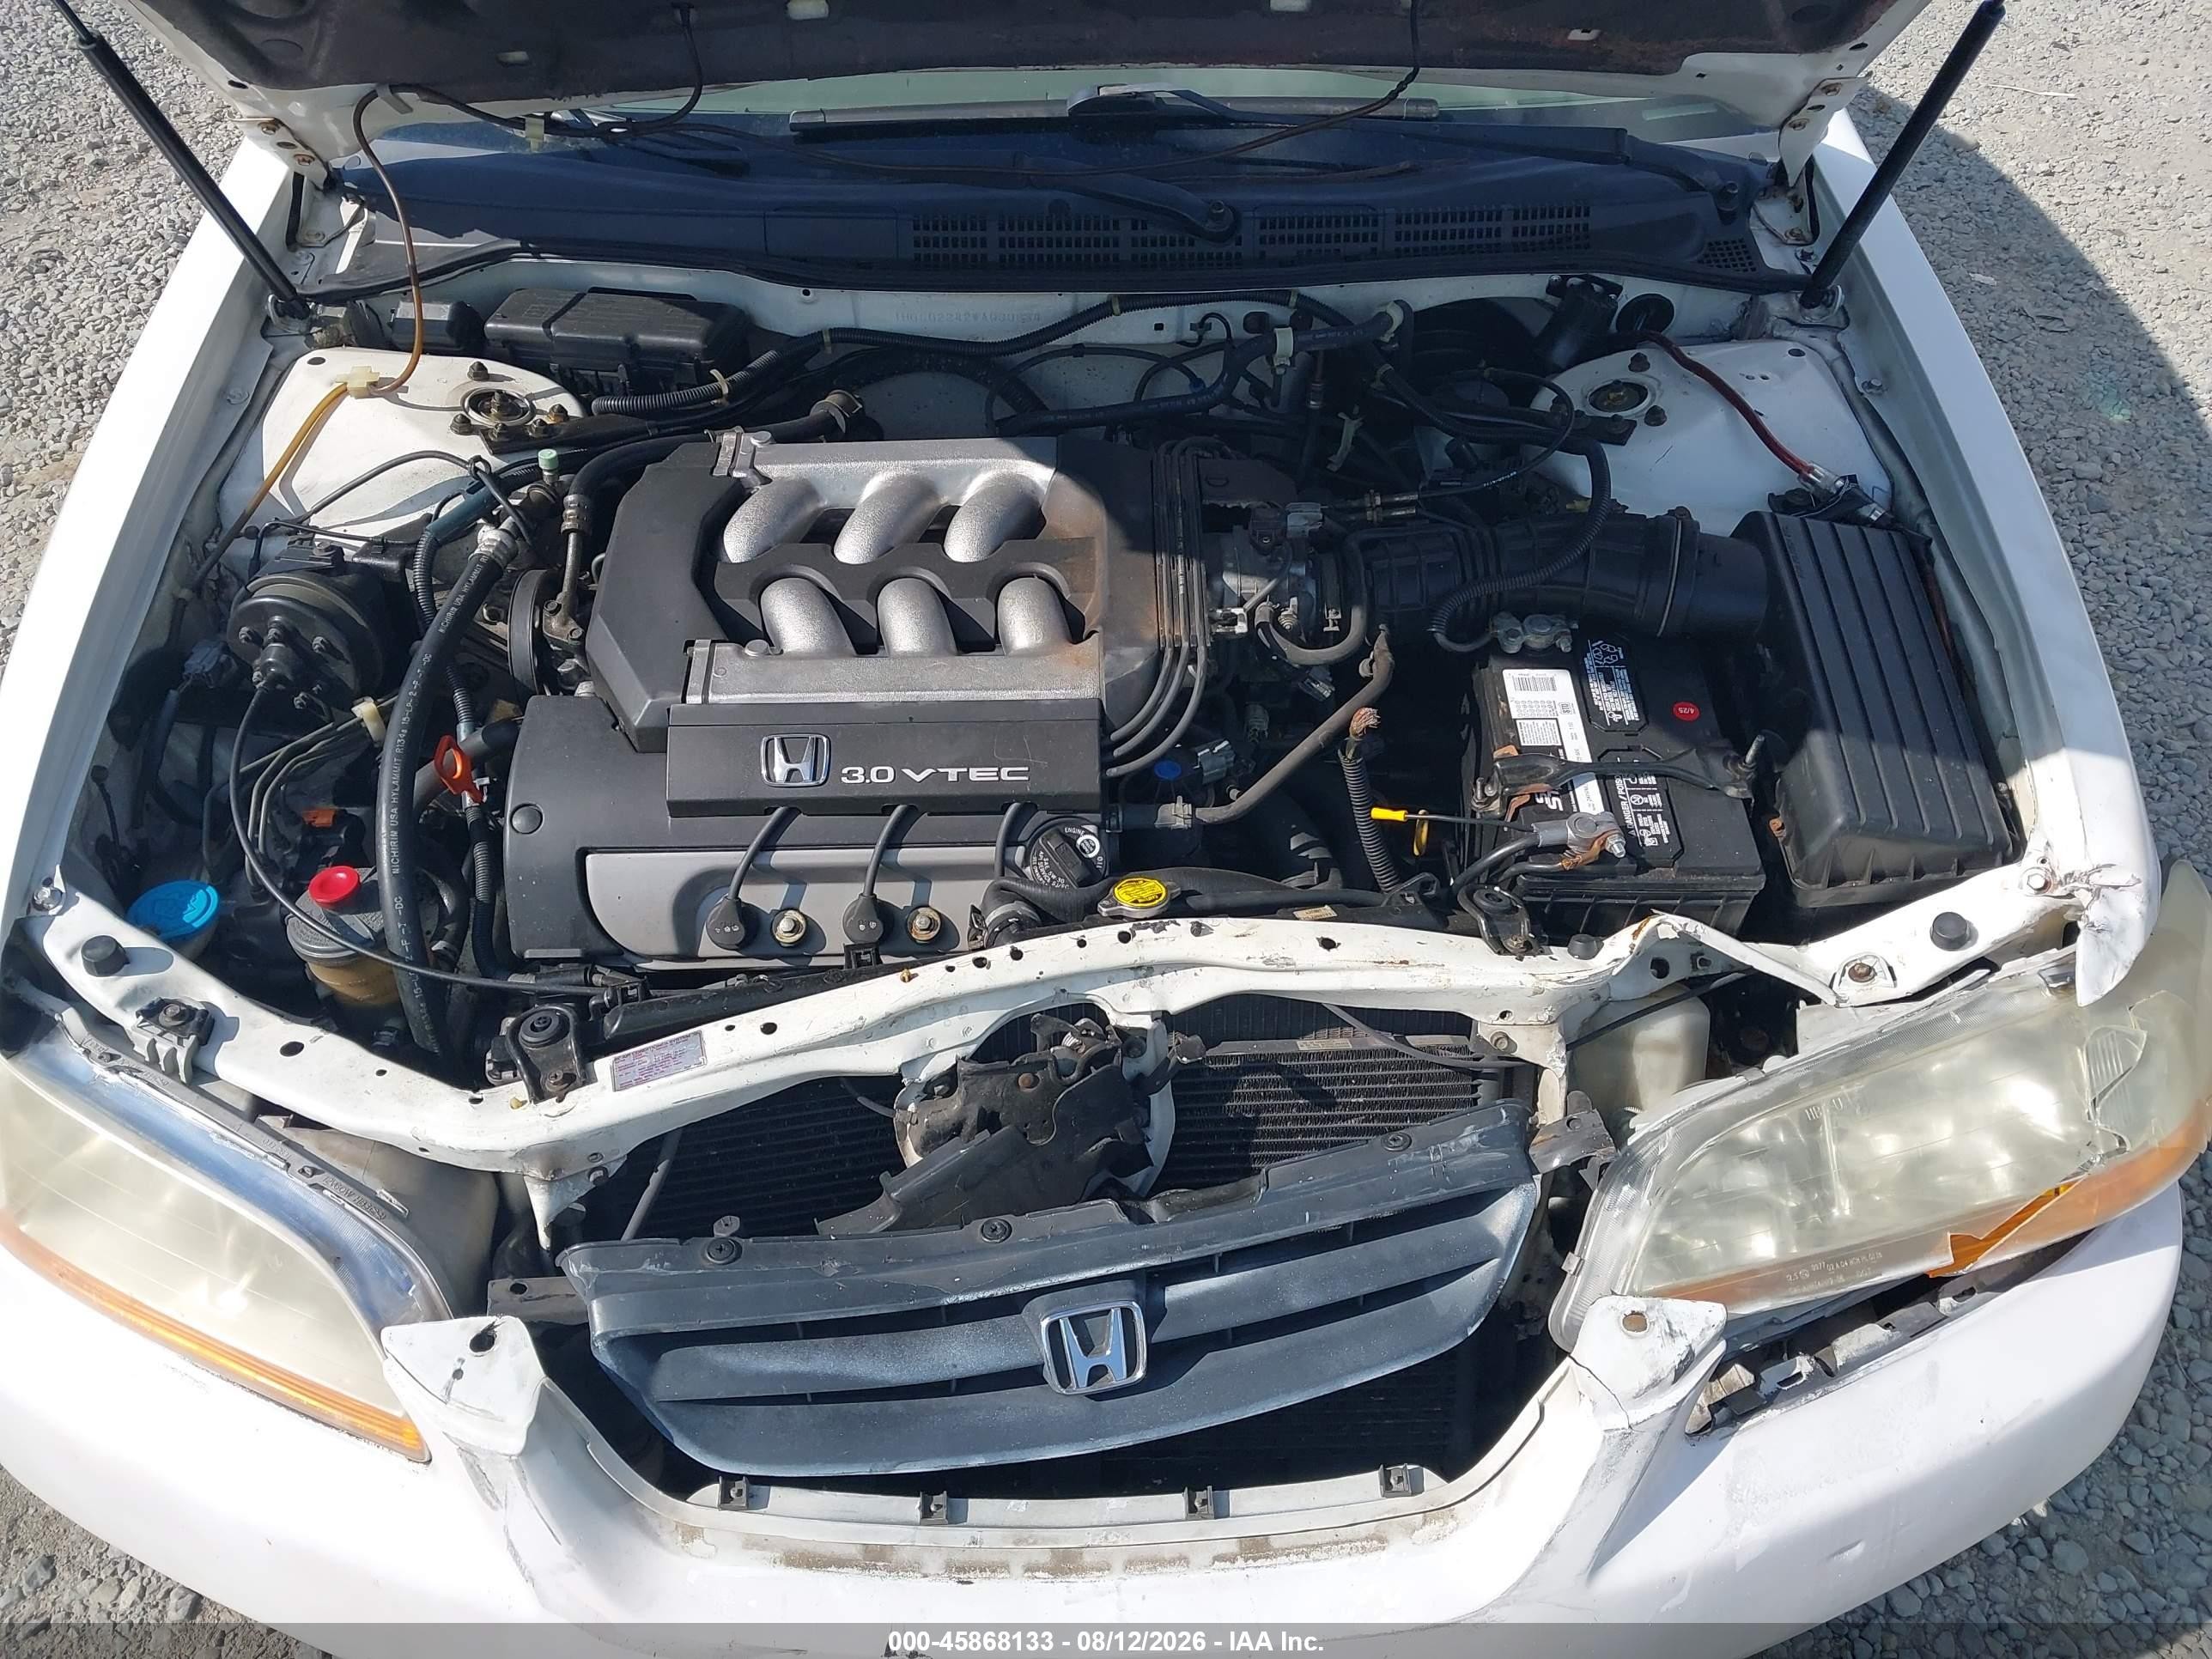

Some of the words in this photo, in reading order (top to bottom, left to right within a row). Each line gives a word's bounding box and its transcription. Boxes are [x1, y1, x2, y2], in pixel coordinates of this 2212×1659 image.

[842, 766, 894, 785] 3.0
[902, 766, 1030, 782] VTEC
[390, 808, 398, 826] USA
[1065, 827, 1085, 836] ENGINE
[390, 831, 399, 874] NICHIRIN
